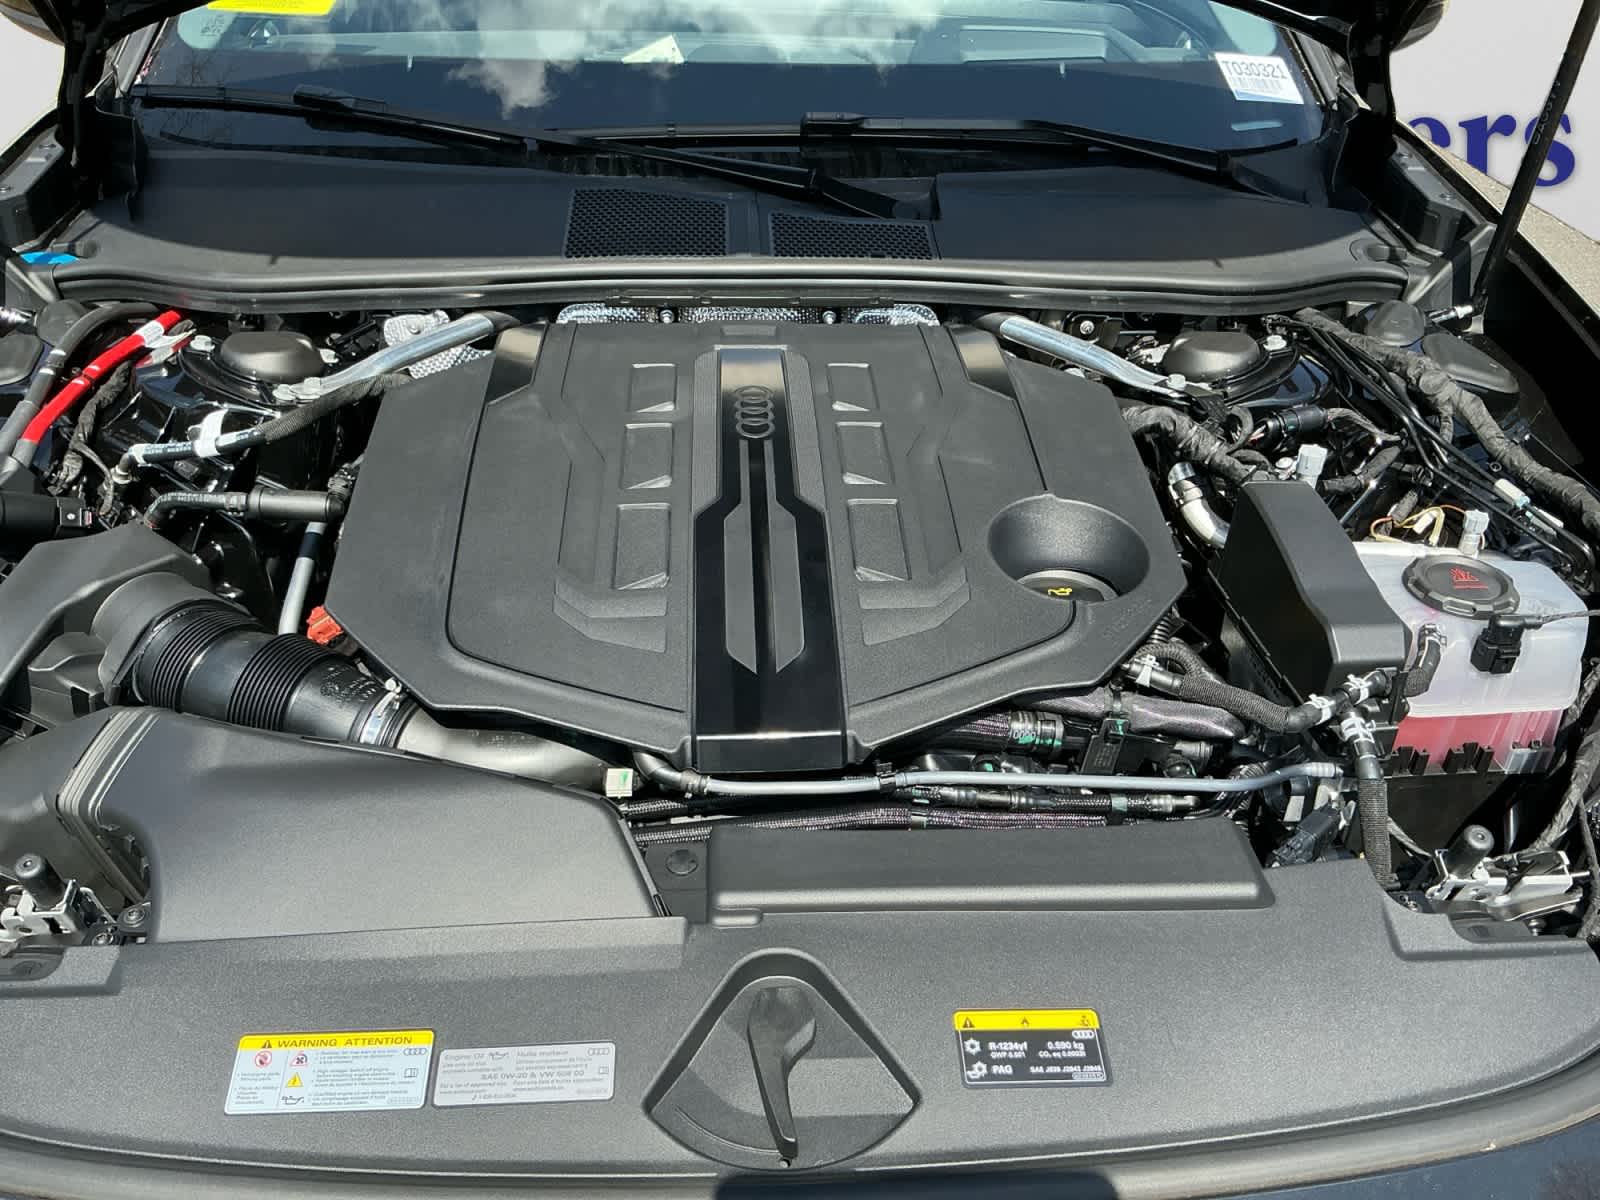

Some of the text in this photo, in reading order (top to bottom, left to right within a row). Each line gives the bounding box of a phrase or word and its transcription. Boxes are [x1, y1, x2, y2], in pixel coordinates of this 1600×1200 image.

[1221, 60, 1288, 79] T030321
[277, 1036, 413, 1048] WARNING ATTENTION
[991, 1065, 1013, 1074] PAG
